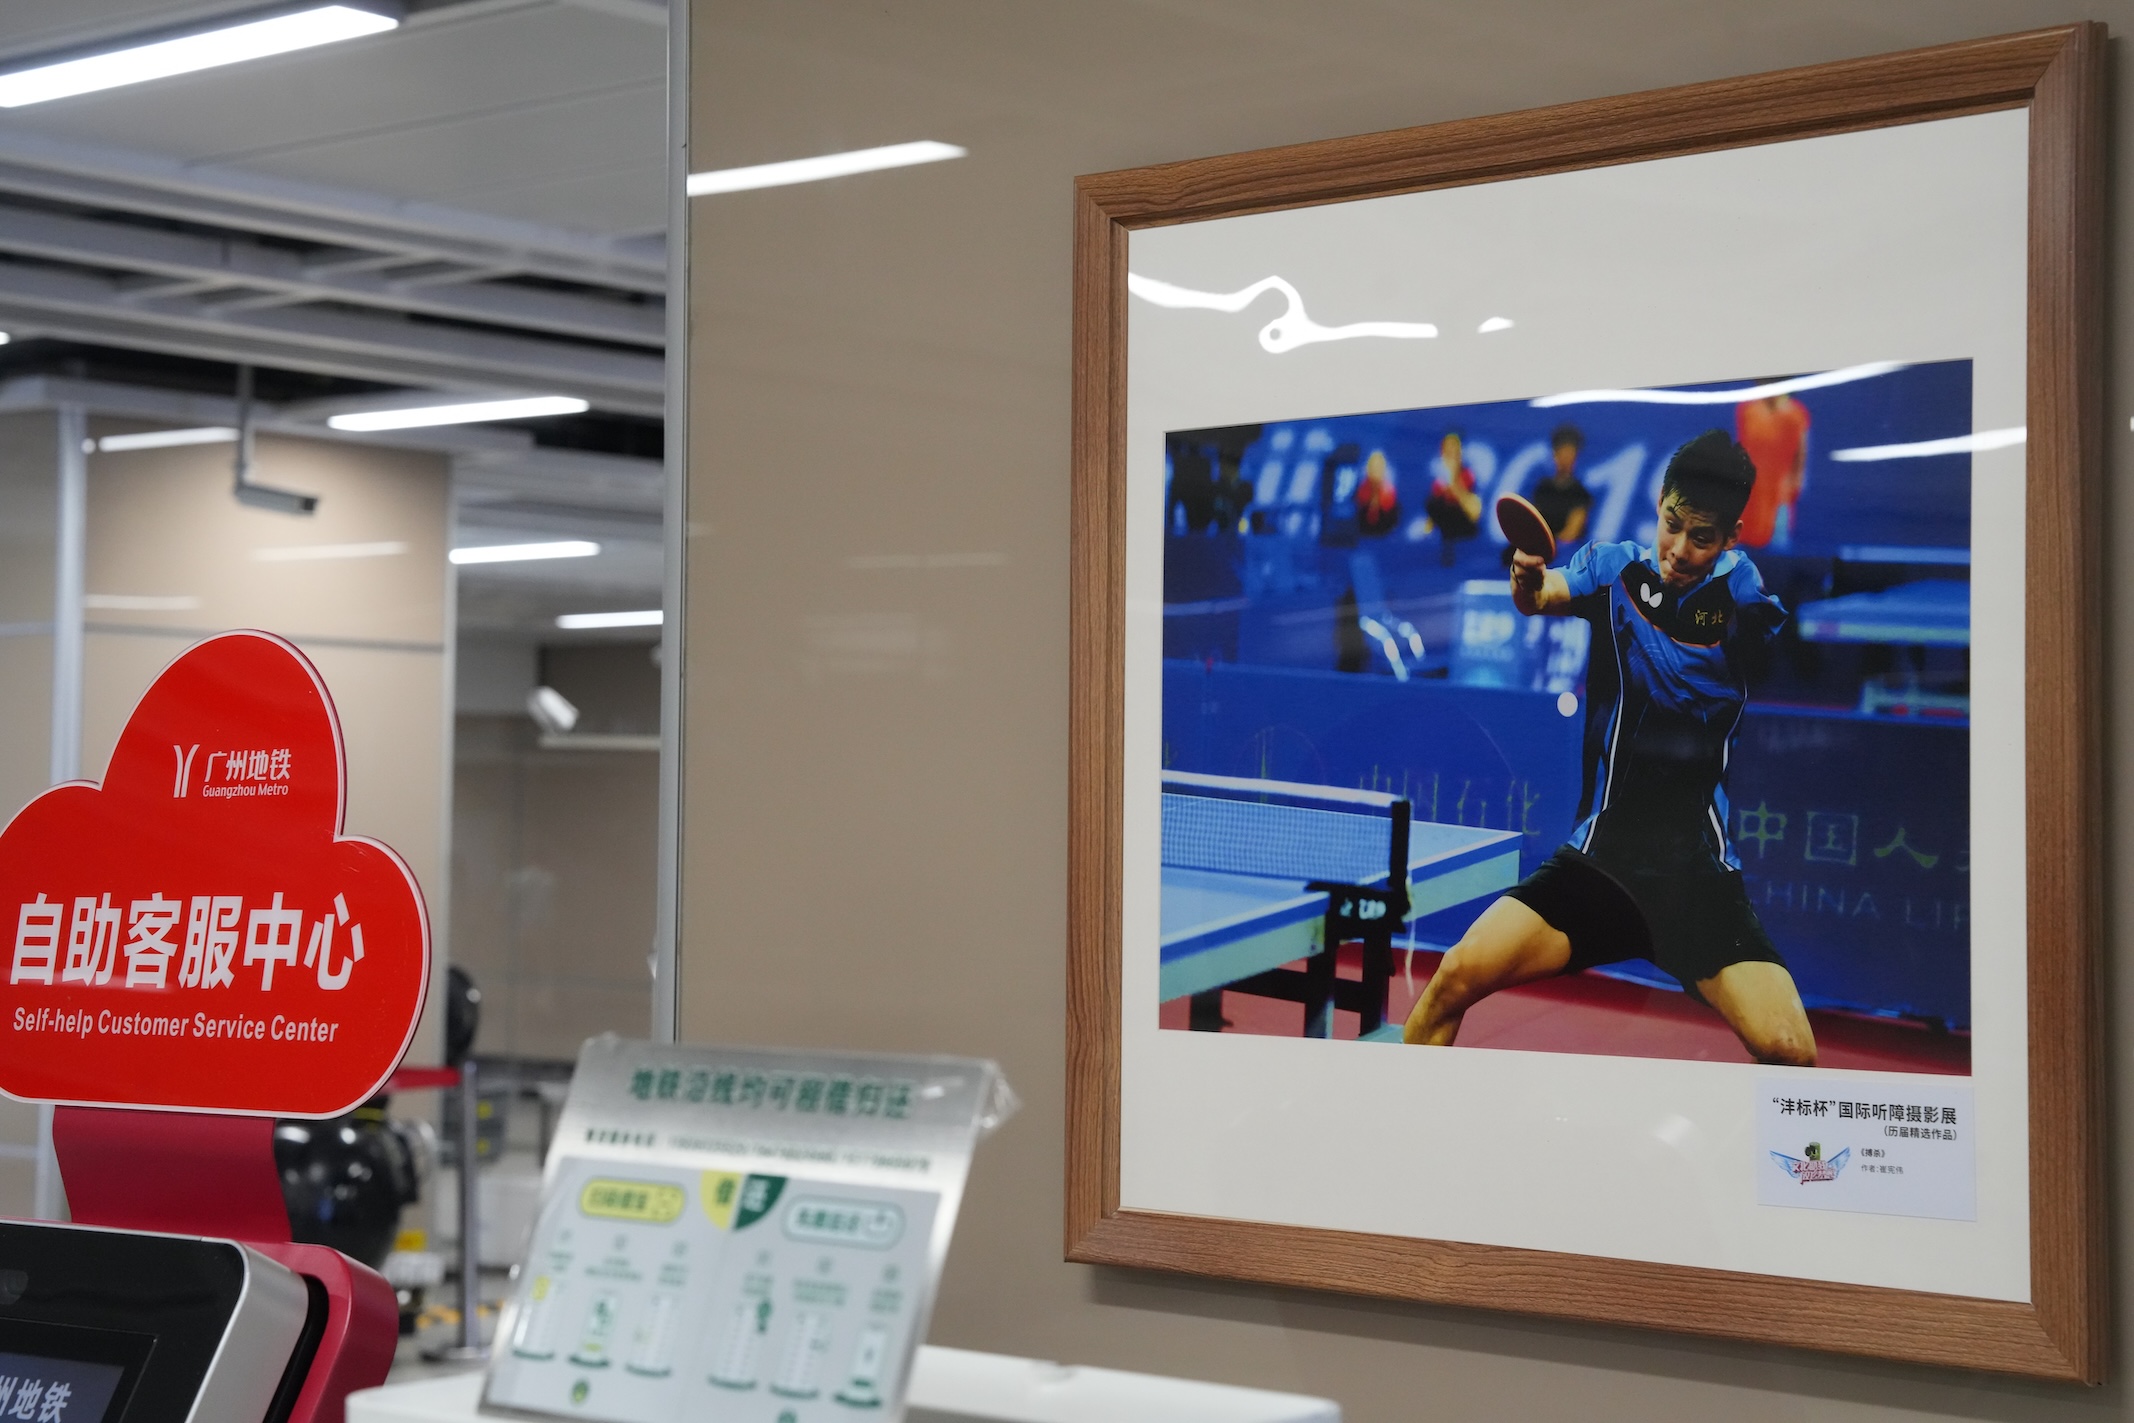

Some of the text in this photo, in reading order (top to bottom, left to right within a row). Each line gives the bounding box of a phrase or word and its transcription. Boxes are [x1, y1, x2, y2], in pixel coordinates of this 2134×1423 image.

[1693, 609, 1724, 626] 河北
[204, 748, 292, 782] 广州地铁
[202, 783, 289, 799] Guangzhou Metro
[1738, 800, 1969, 868] 中国人
[9, 892, 365, 991] 自助客服中心
[13, 1006, 339, 1042] Self-help Customer Service Center
